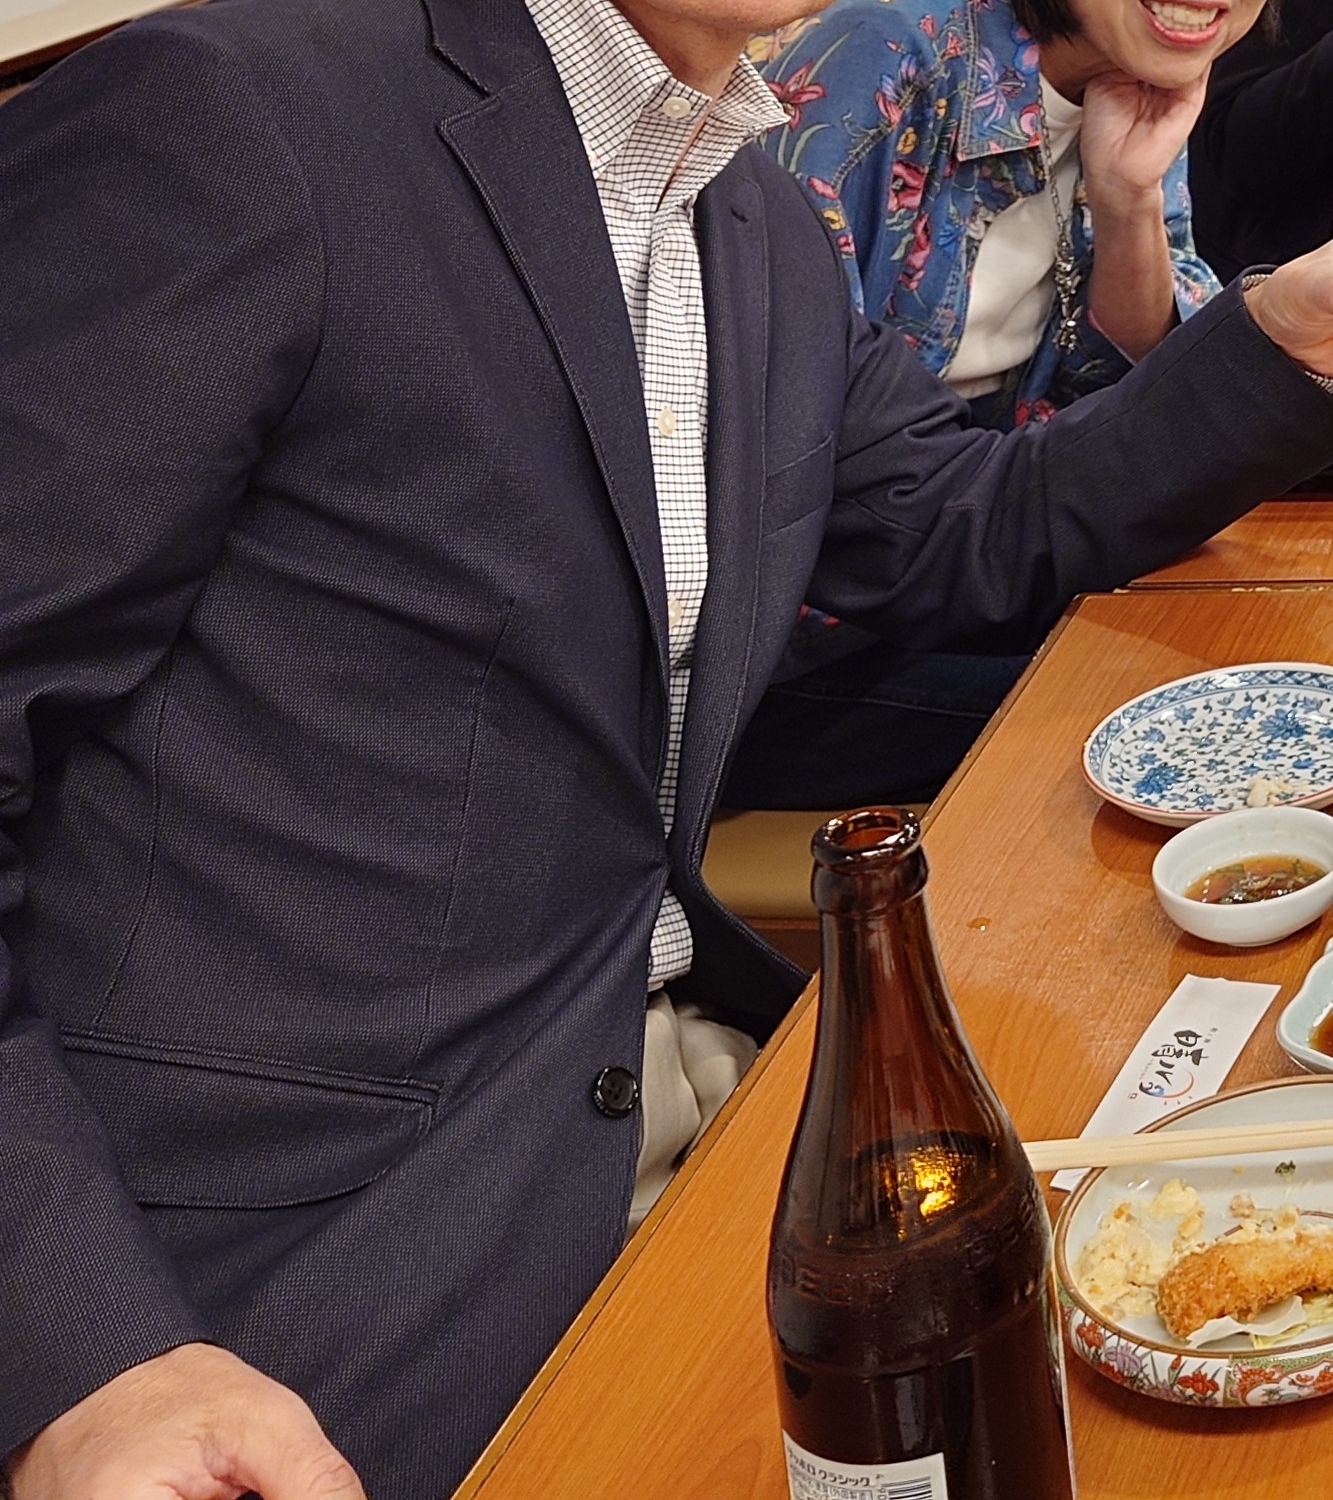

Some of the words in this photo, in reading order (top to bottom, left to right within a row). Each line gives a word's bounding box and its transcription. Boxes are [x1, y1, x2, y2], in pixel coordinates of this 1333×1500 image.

[818, 1468, 871, 1488] クラシック
